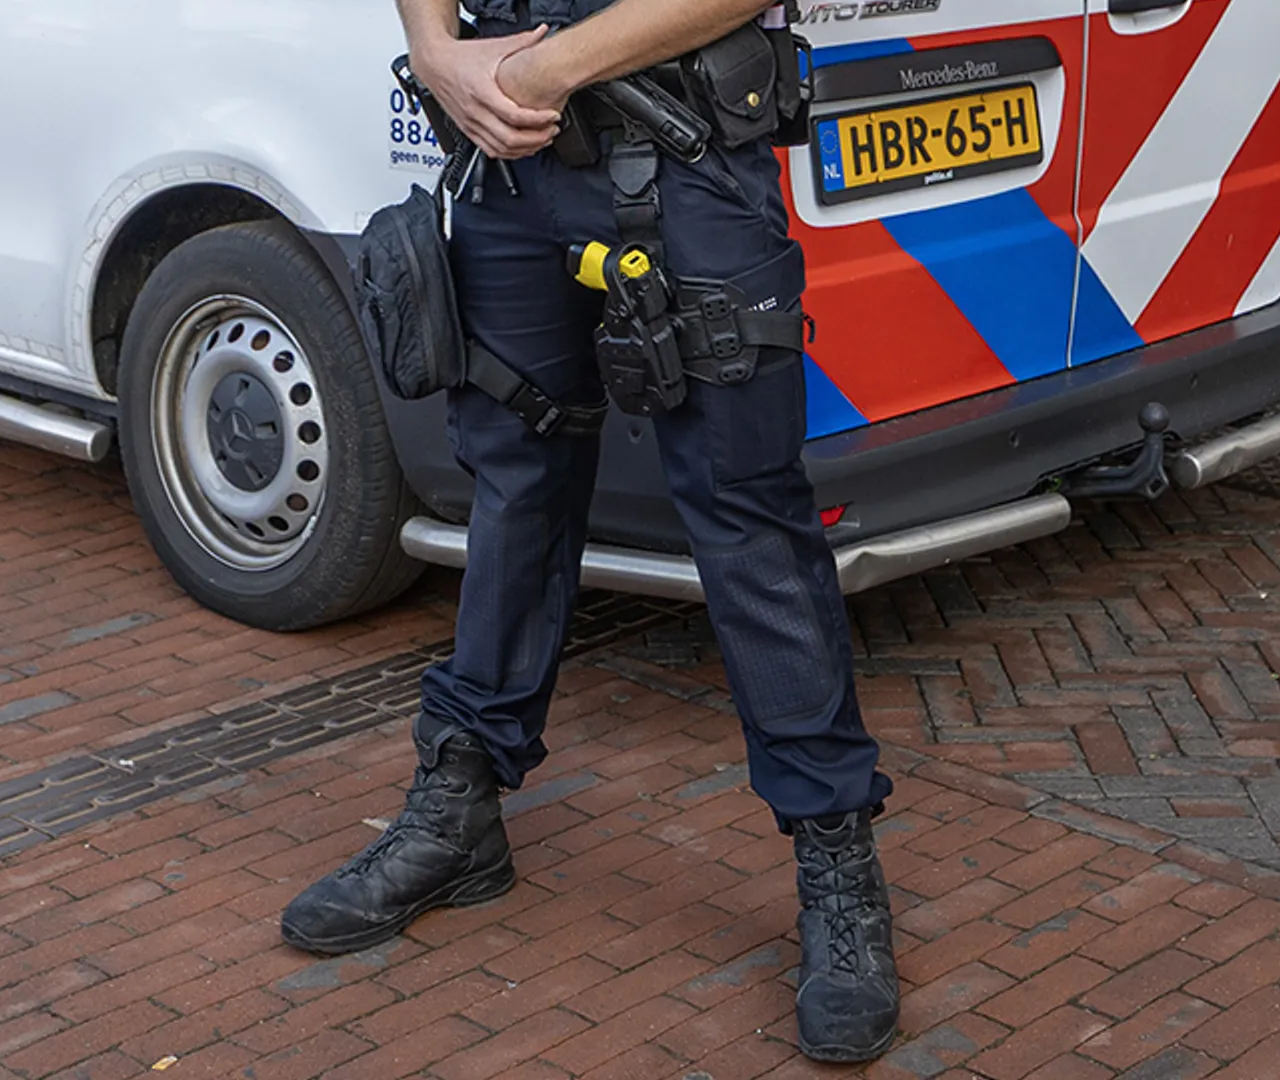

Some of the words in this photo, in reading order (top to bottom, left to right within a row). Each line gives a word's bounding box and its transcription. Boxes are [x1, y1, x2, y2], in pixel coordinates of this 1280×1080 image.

[900, 60, 1000, 90] Mercedes-Benz
[823, 163, 841, 180] NL
[850, 98, 1029, 177] HBR-65-H
[390, 150, 420, 165] geen
